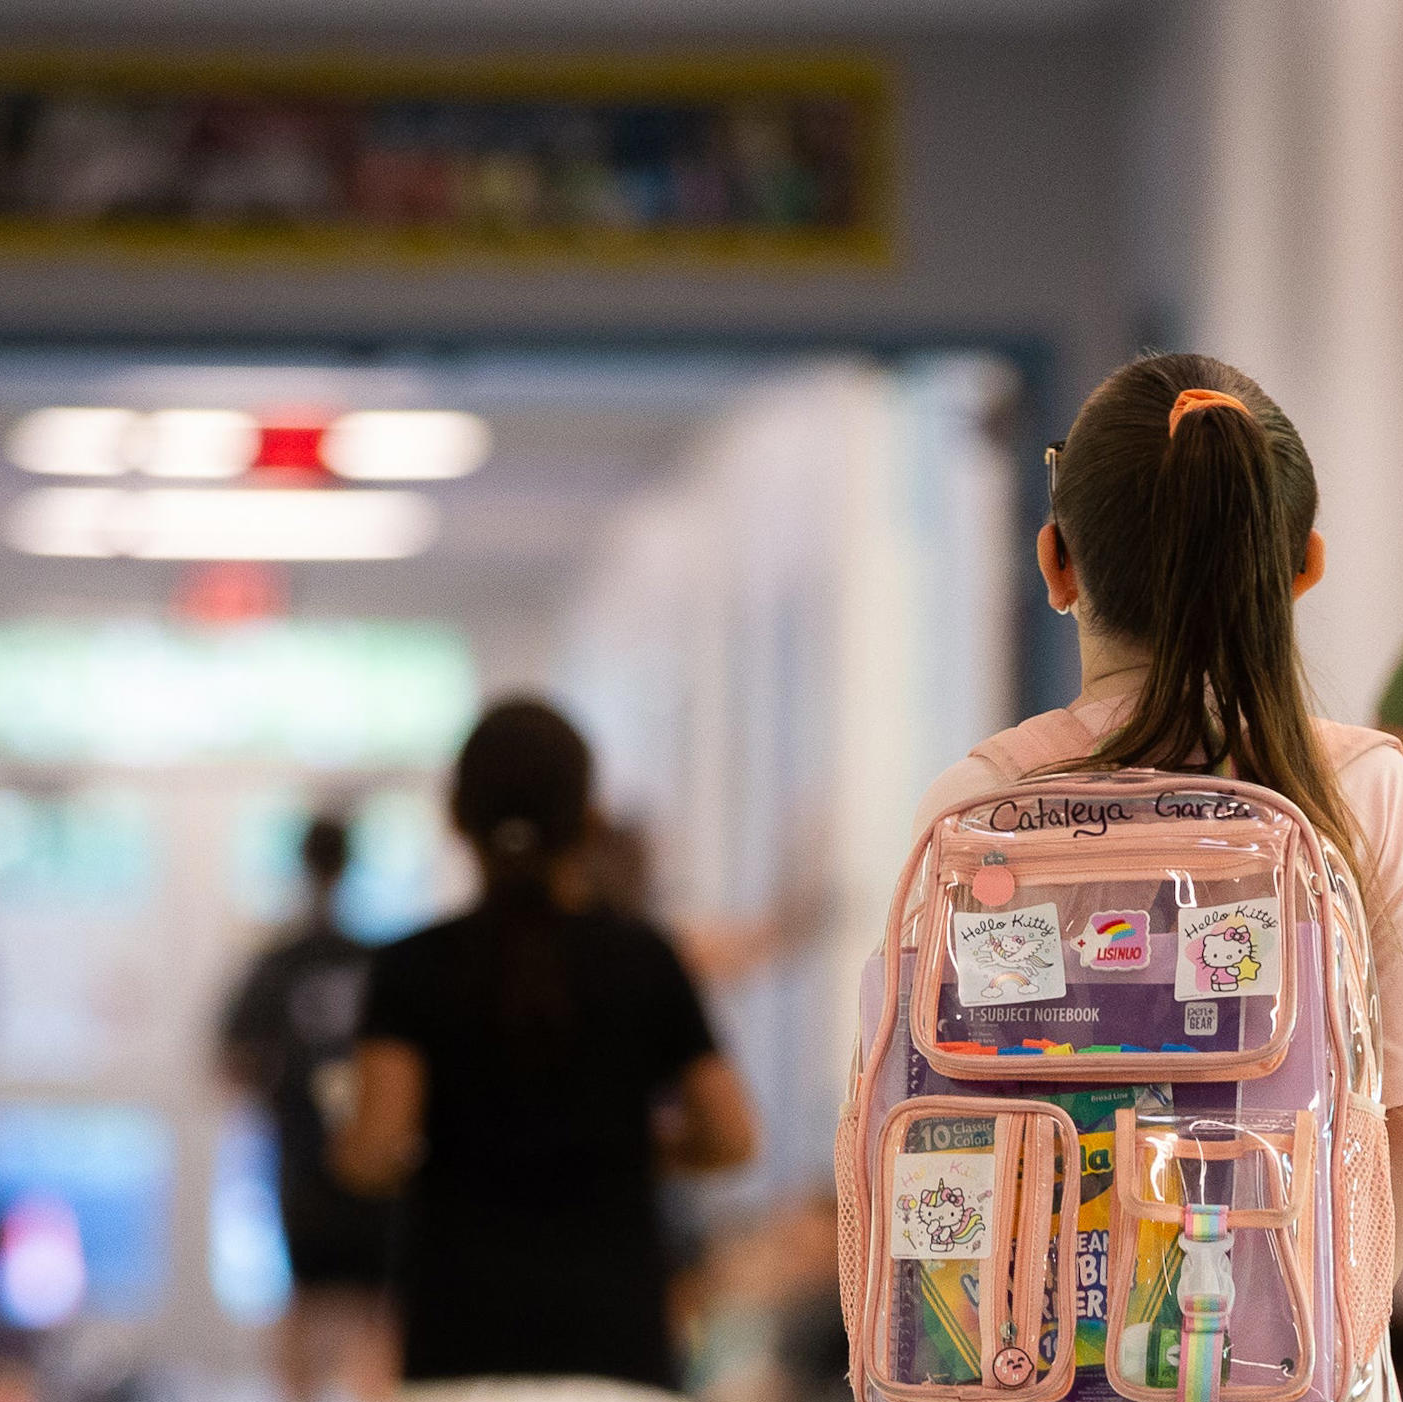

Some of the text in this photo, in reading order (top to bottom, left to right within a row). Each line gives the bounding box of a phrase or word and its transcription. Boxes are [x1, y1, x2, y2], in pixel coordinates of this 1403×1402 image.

[989, 798, 1134, 838] Cataleya
[961, 914, 1056, 942] Hello Kitty
[1184, 905, 1278, 939] Hello Kitty
[1096, 947, 1142, 961] LISINUO
[968, 1007, 1100, 1022] 1-SUBJECT NOTEBOOK
[1189, 1017, 1213, 1030] GEAR
[953, 1121, 991, 1134] Classic
[920, 1124, 951, 1151] 10
[954, 1134, 992, 1147] Colors
